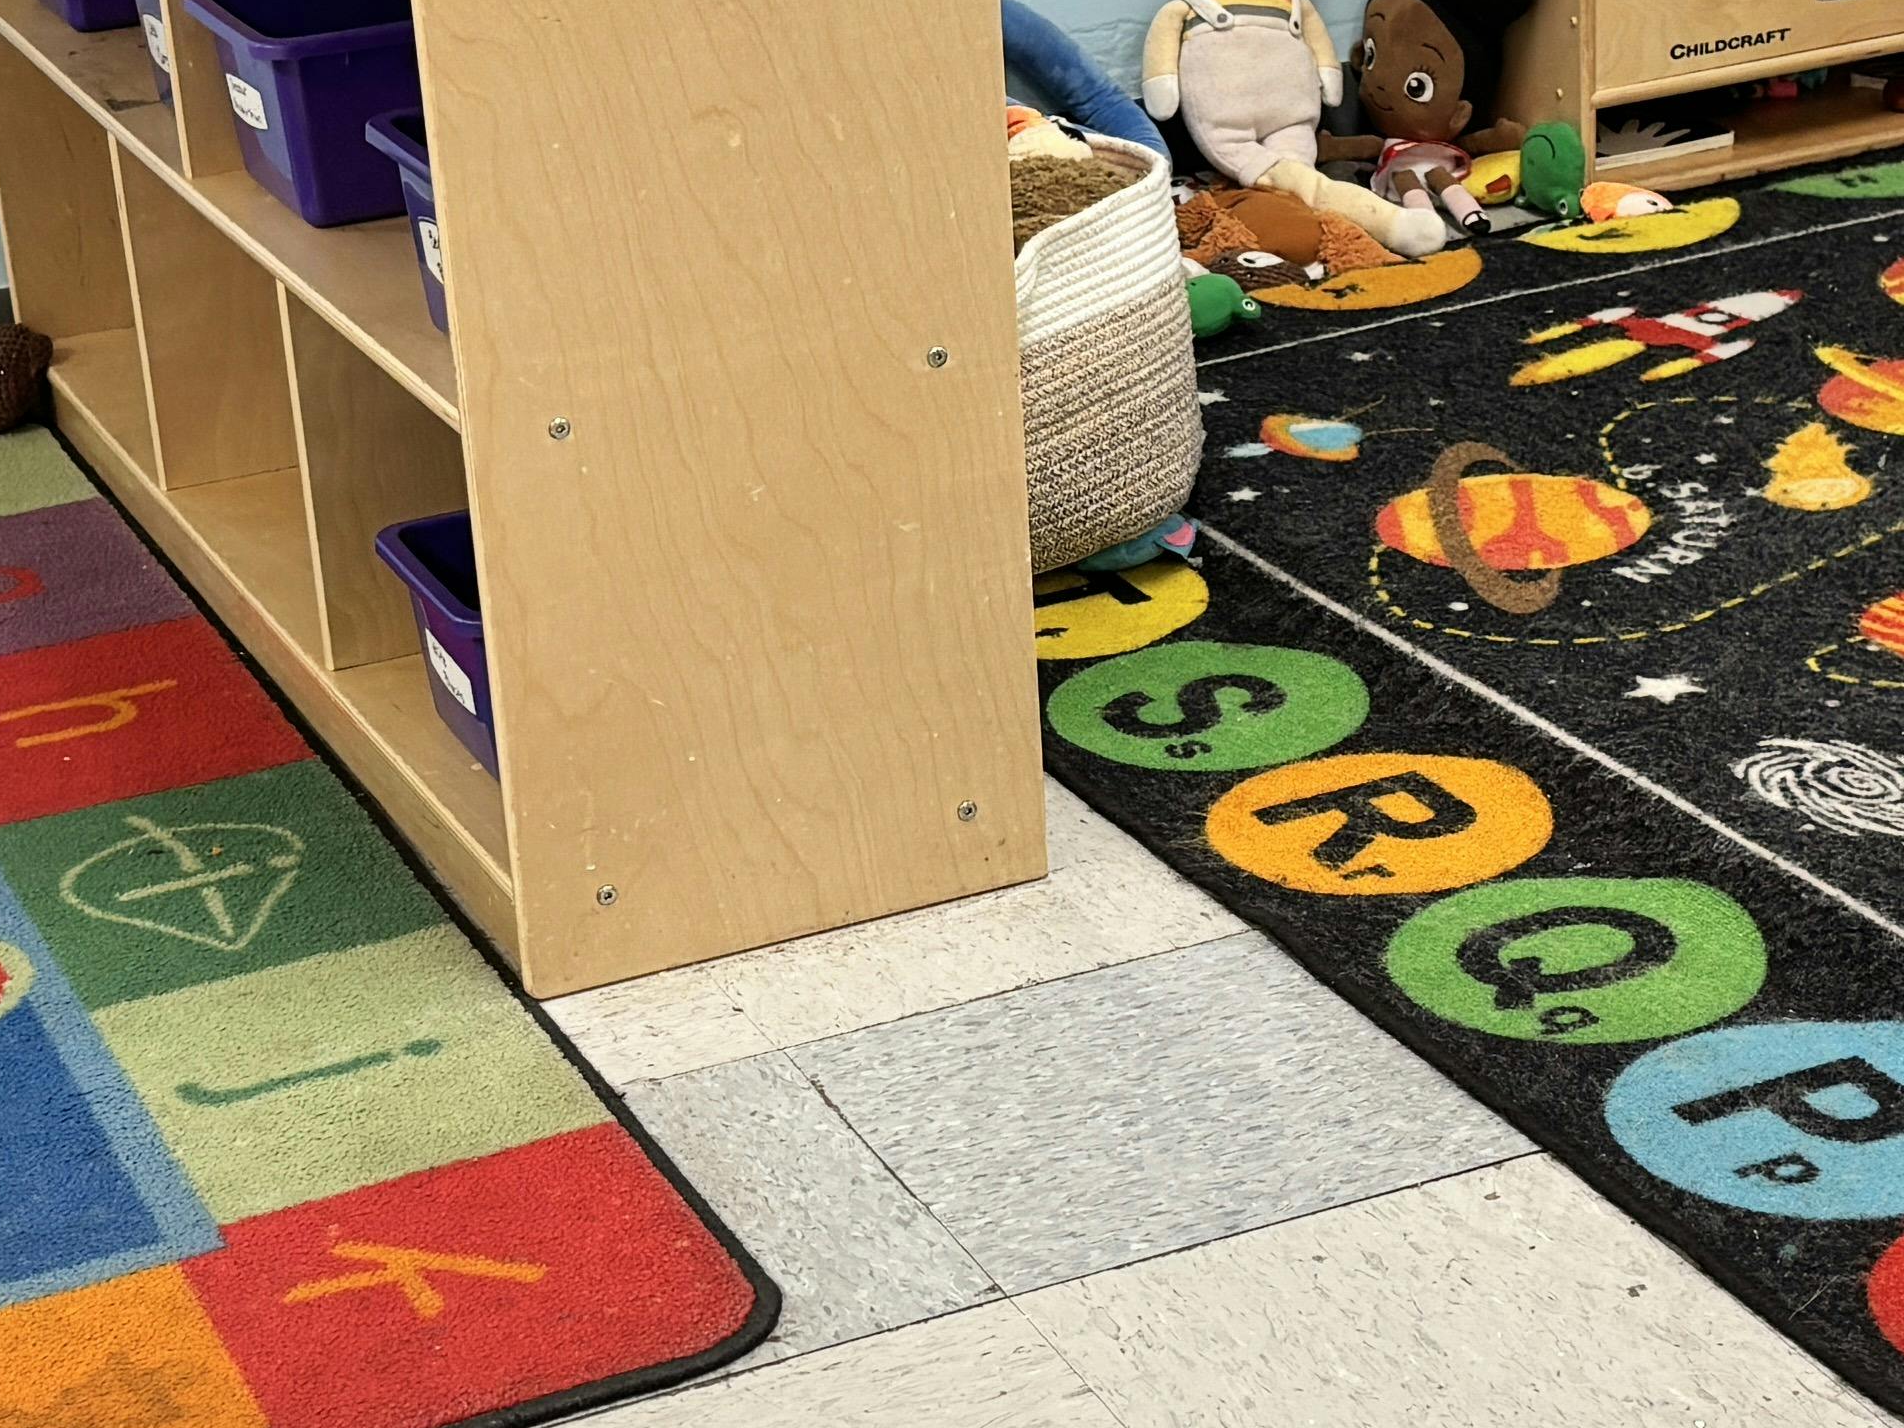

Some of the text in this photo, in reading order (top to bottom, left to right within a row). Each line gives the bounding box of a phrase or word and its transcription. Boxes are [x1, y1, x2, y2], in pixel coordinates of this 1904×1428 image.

[1669, 27, 1792, 61] CHILDCRAFT
[1611, 481, 1738, 585] SATURN
[1099, 672, 1289, 740] S
[1251, 769, 1478, 872] R
[1454, 902, 1680, 1012] Q
